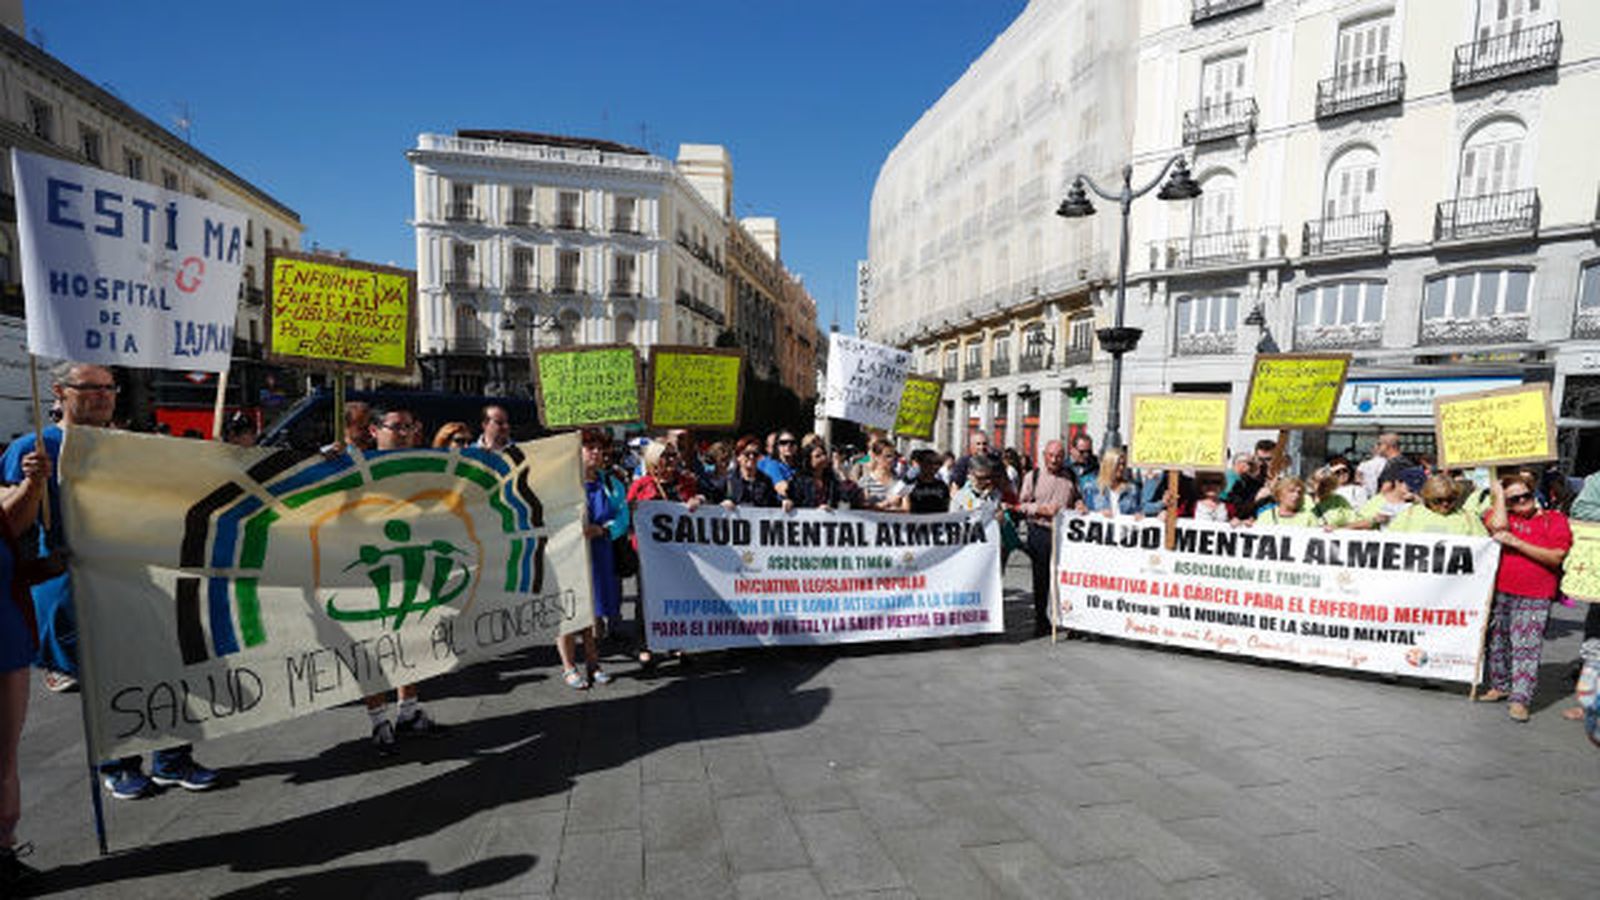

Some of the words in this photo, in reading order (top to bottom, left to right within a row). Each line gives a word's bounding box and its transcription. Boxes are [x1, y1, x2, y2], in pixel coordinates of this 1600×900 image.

[50, 270, 171, 310] HOSPITAL
[278, 264, 369, 295] INFORME
[100, 310, 121, 325] DE
[652, 514, 752, 546] SALUD
[760, 519, 868, 547] MENTAL
[875, 516, 988, 547] ALMERÍA
[1067, 518, 1160, 550] SALUD
[1173, 527, 1296, 562] MENTAL
[1302, 537, 1475, 575] ALMERÍA
[1258, 568, 1272, 584] EL
[1060, 570, 1147, 594] ALTERNATIVA
[1151, 581, 1160, 595] A
[1163, 582, 1180, 598] LA
[1243, 591, 1284, 611] PARA
[1288, 596, 1305, 614] EL
[1309, 599, 1388, 623] ENFERMO
[652, 620, 688, 637] PARA
[772, 618, 820, 635] MENTAL
[832, 617, 846, 632] LA
[1194, 606, 1256, 628] MUNDIAL
[1259, 615, 1277, 631] DE
[1280, 619, 1297, 634] LA
[1300, 621, 1350, 640] SALUD
[111, 665, 264, 740] SALUD
[286, 632, 417, 709] MENTAL
[431, 620, 468, 659] AL
[474, 588, 578, 645] CONGRESO
